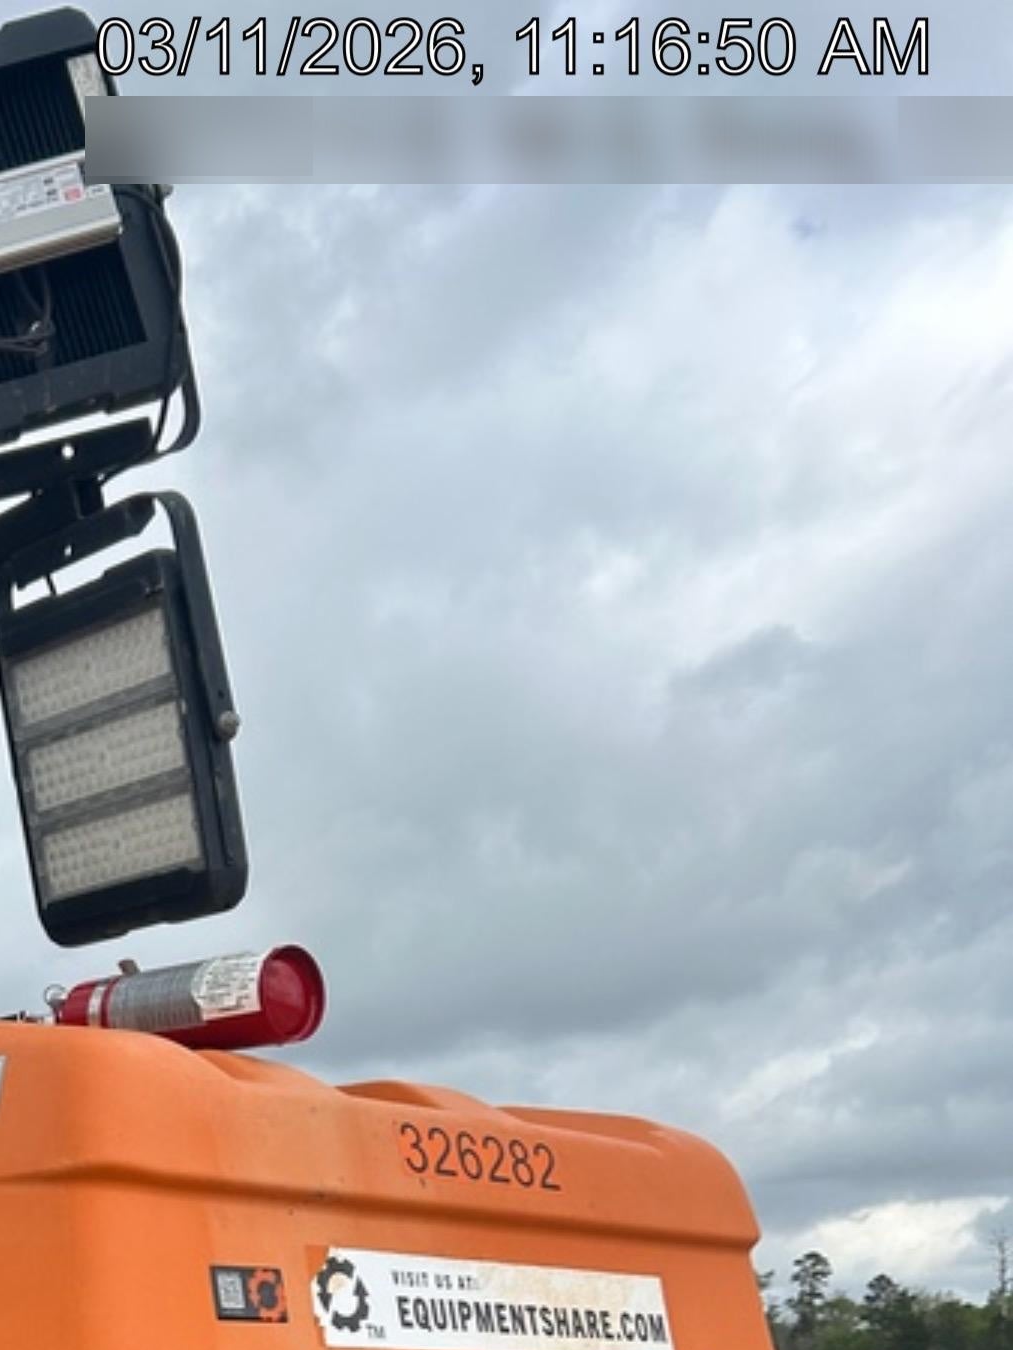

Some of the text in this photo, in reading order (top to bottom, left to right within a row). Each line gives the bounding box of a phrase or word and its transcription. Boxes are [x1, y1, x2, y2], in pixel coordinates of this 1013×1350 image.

[399, 1122, 561, 1191] 326282
[391, 1271, 429, 1288] VISIT
[433, 1274, 453, 1291] US
[396, 1295, 667, 1343] EQUIPMENTSHARE.COM
